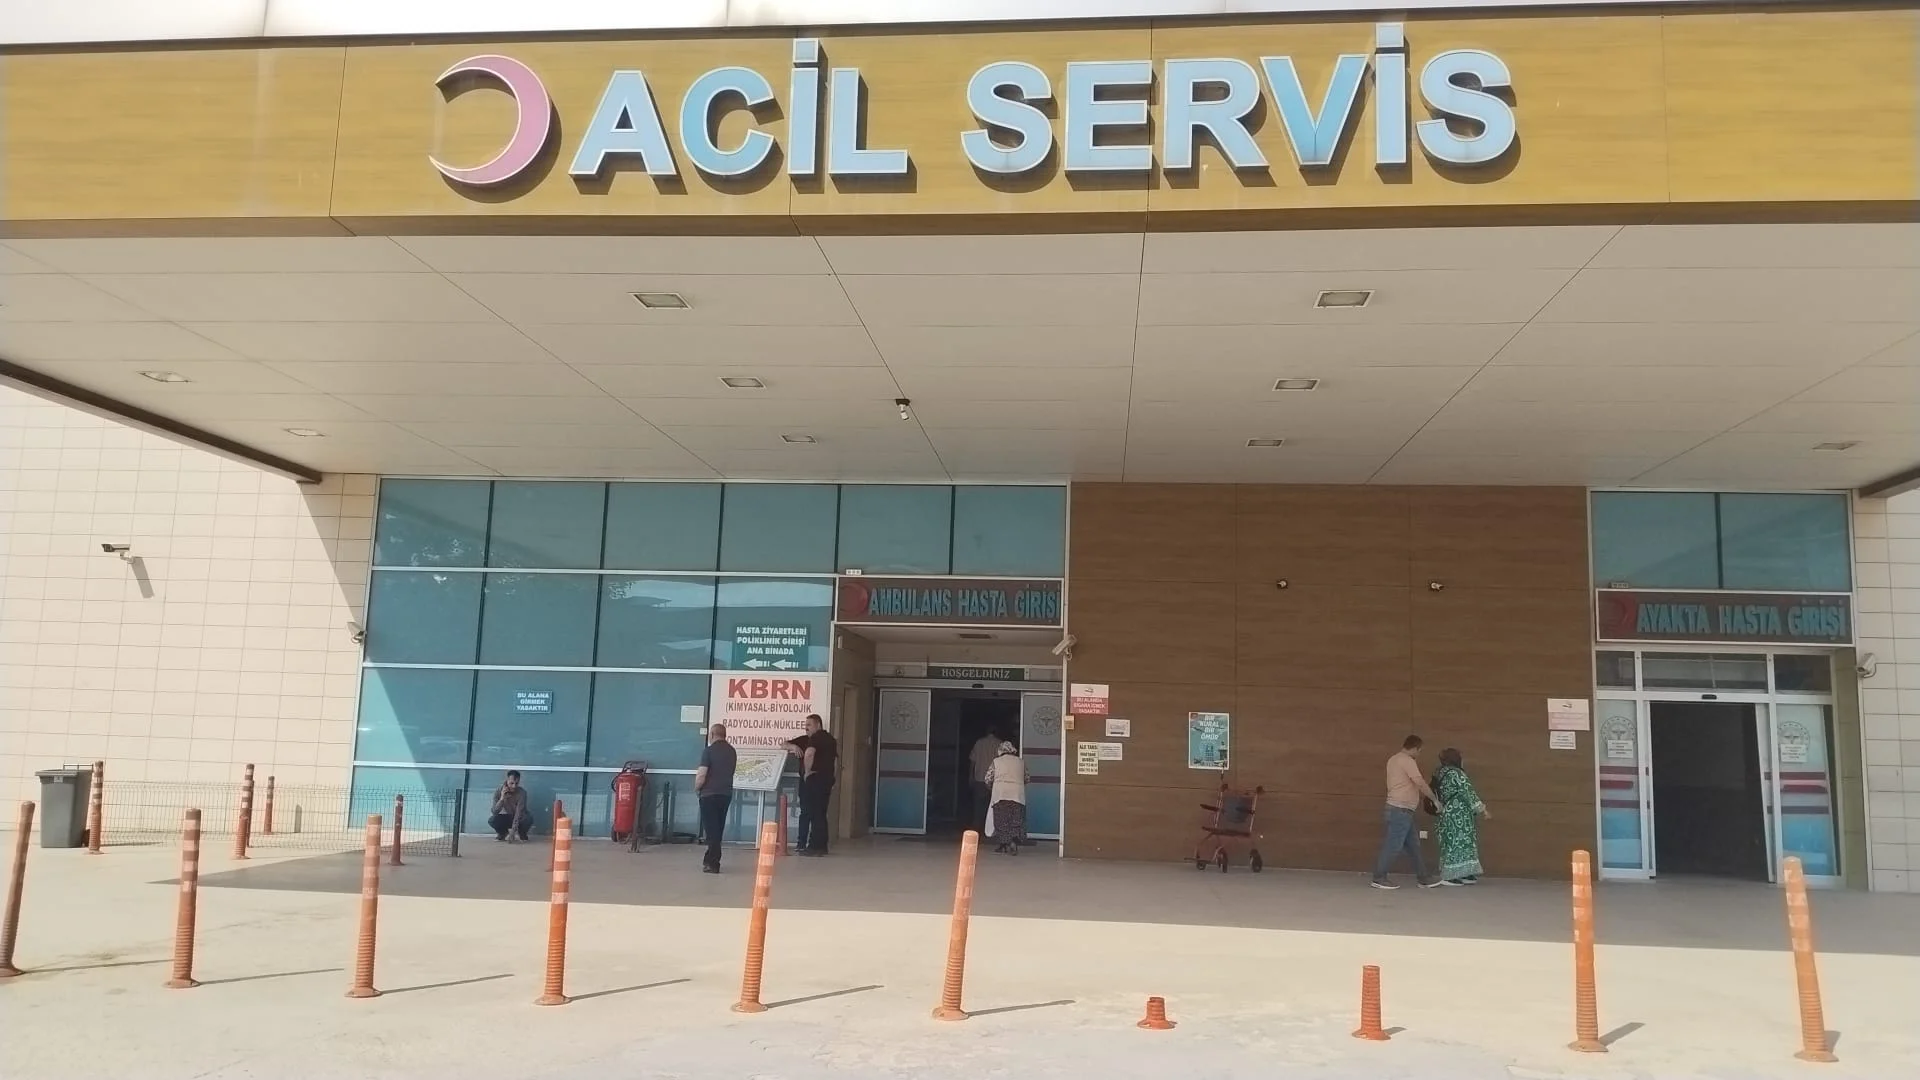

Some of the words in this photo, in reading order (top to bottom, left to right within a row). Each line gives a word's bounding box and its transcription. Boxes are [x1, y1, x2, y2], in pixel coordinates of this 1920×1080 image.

[568, 37, 908, 176] ACİL
[960, 22, 1516, 173] SERVİS
[868, 587, 952, 617] AMBULANS
[958, 589, 1008, 617] HASTA
[1014, 583, 1061, 623] GİRİŞİ
[1637, 603, 1712, 634] AYAKTA
[1719, 604, 1782, 636] HASTA
[1788, 599, 1847, 641] GİRİŞİ
[736, 626, 760, 634] HASTA
[761, 625, 807, 635] ZİYARETLERİ
[737, 635, 780, 645] POLİKLİNİK
[782, 636, 806, 647] GİRİŞİ
[765, 646, 794, 655] BİNADA
[941, 667, 1011, 680] HOŞGELDİNİZ
[728, 678, 811, 700] KBRN
[722, 717, 806, 730] RADYOLOJİK-NÜKLEE
[727, 735, 789, 746] ONTAMİNASYO
